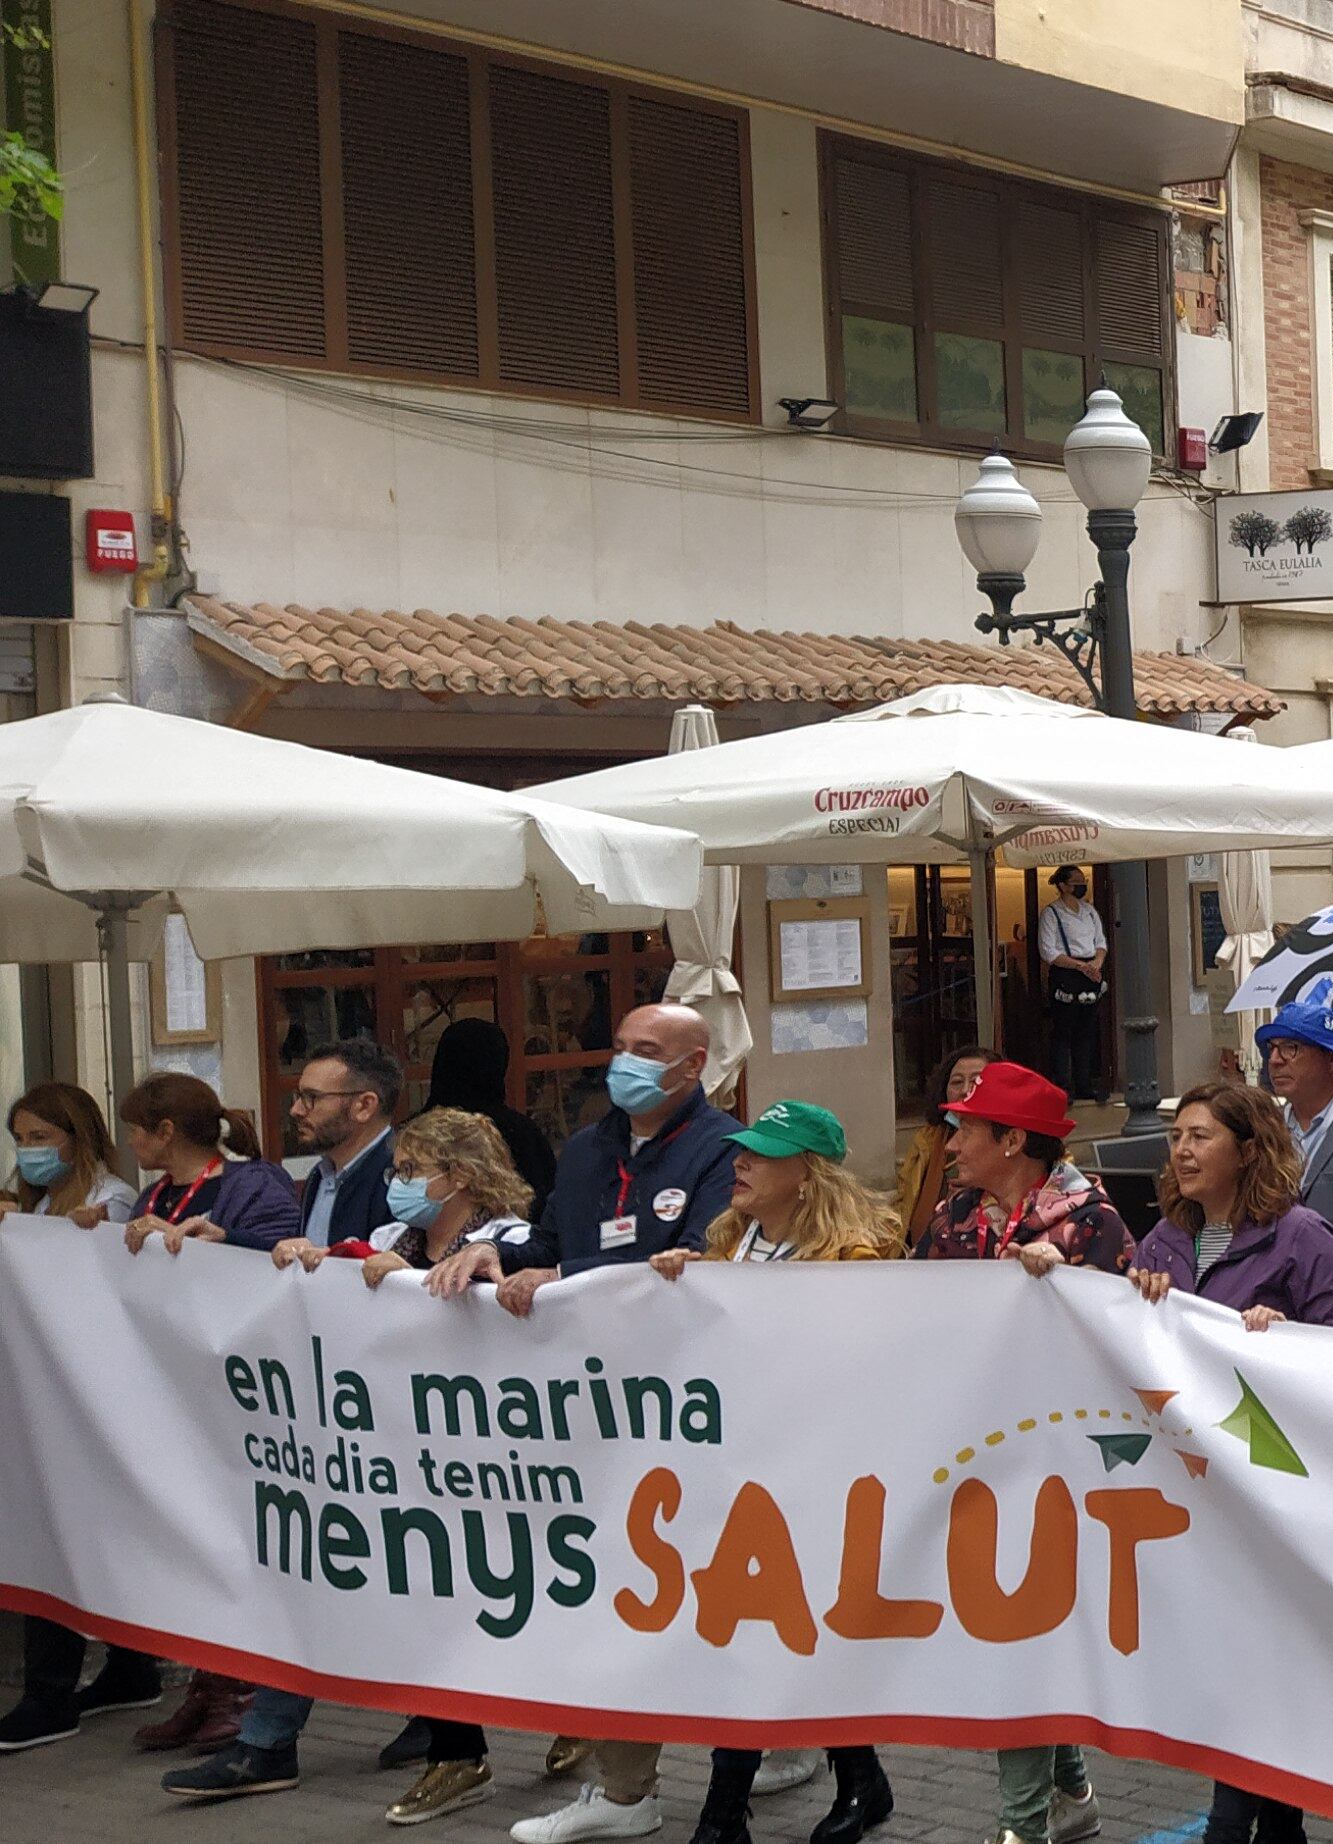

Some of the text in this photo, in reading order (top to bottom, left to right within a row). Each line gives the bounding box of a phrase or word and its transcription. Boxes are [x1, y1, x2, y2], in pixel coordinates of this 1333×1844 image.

[1243, 559, 1276, 571] TASCA
[814, 786, 930, 814] Cruzcampo
[225, 1335, 723, 1446] en la marina
[244, 1424, 584, 1504] cada dia tenim
[254, 1466, 1191, 1657] menys SALUT
